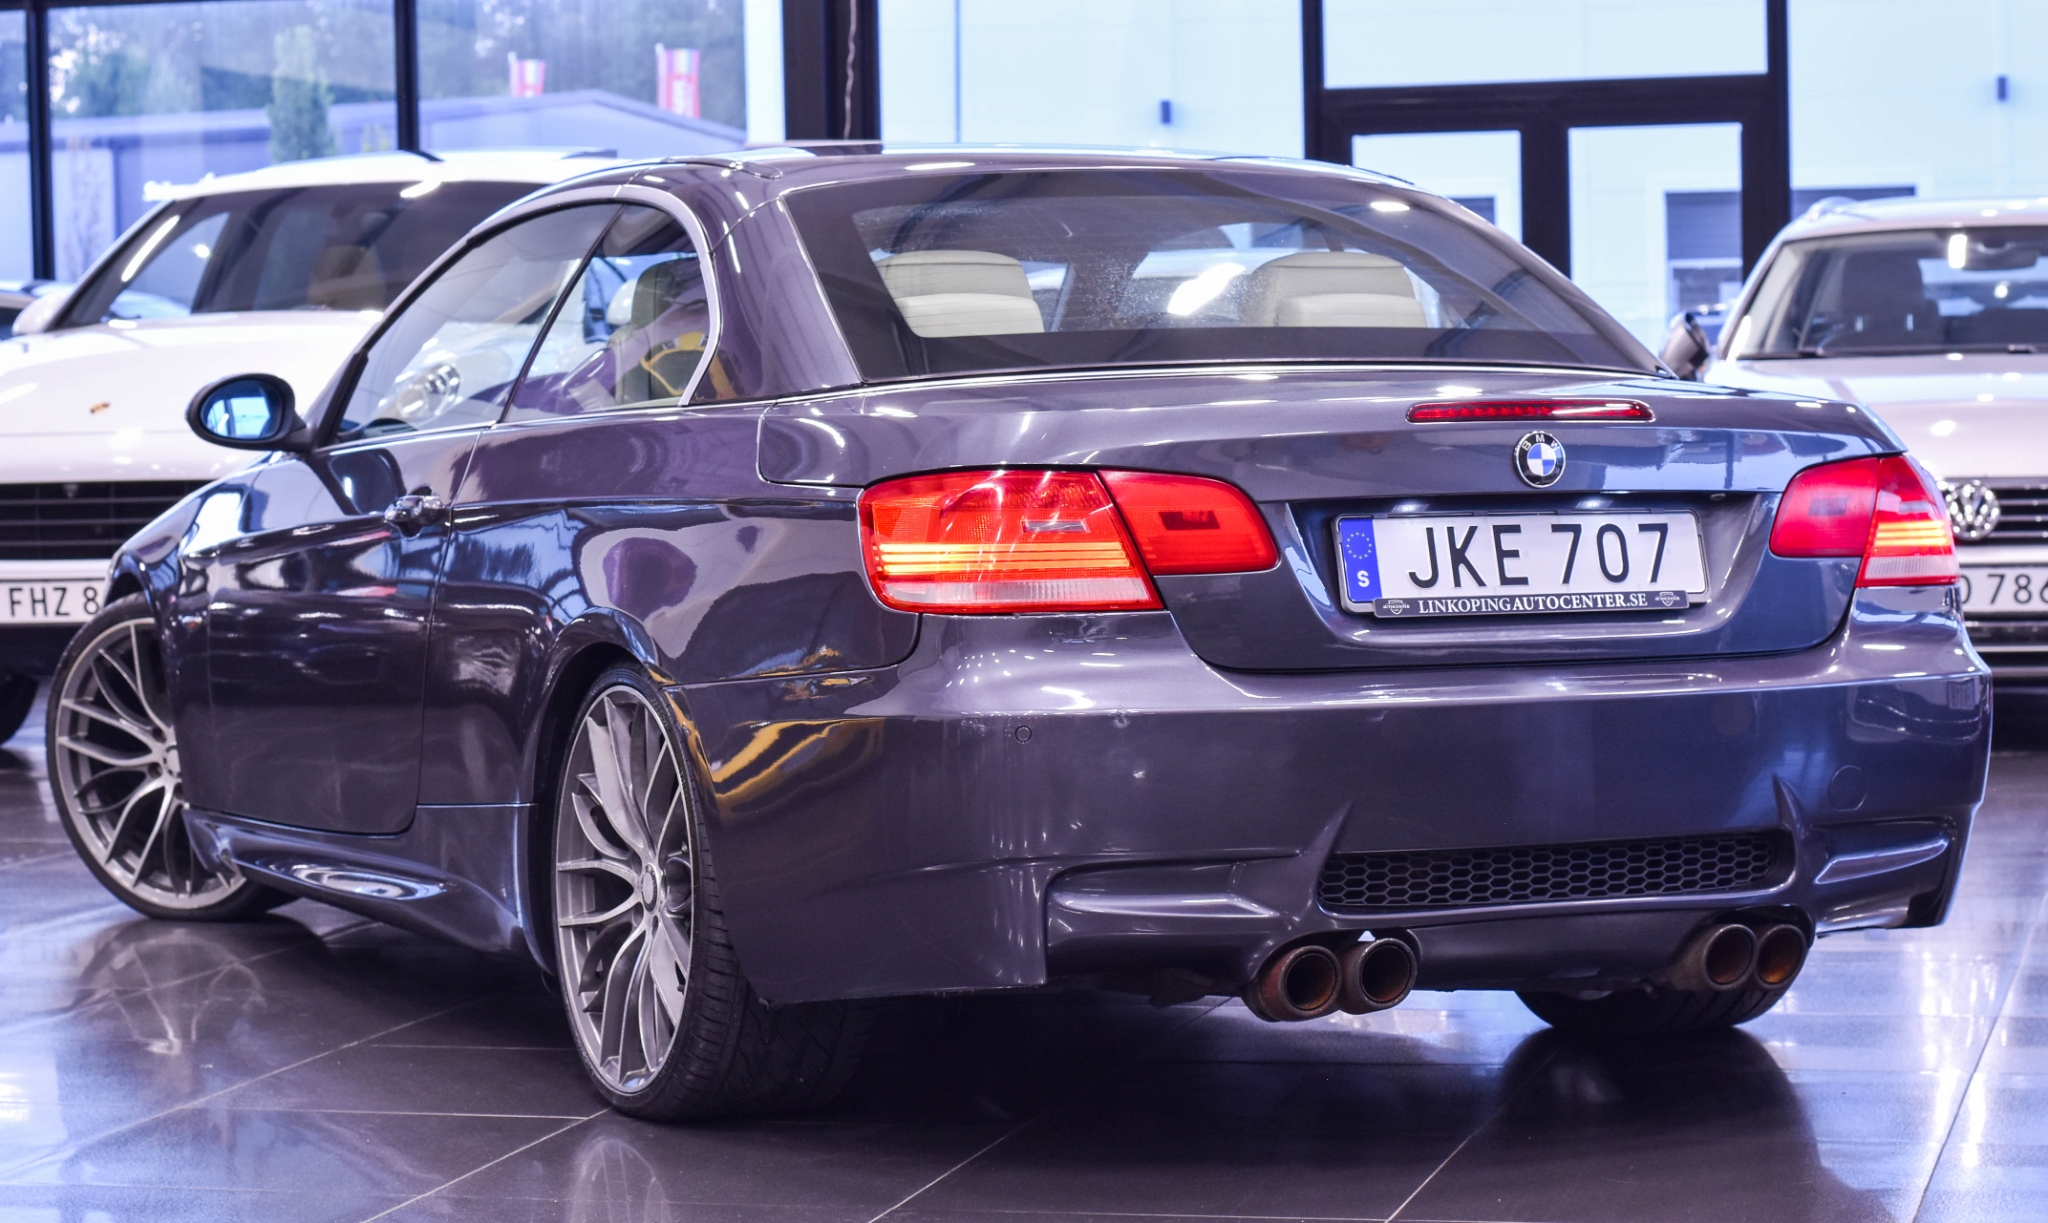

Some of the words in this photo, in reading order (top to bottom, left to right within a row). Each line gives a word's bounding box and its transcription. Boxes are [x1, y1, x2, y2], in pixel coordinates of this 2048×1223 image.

[1521, 433, 1561, 451] BMW
[1408, 523, 1529, 589] JKE
[1551, 522, 1669, 585] 707
[1357, 571, 1370, 588] S
[9, 586, 70, 617] FHZ
[1418, 593, 1648, 614] LINKOPINGAUTOCENTER.SE
